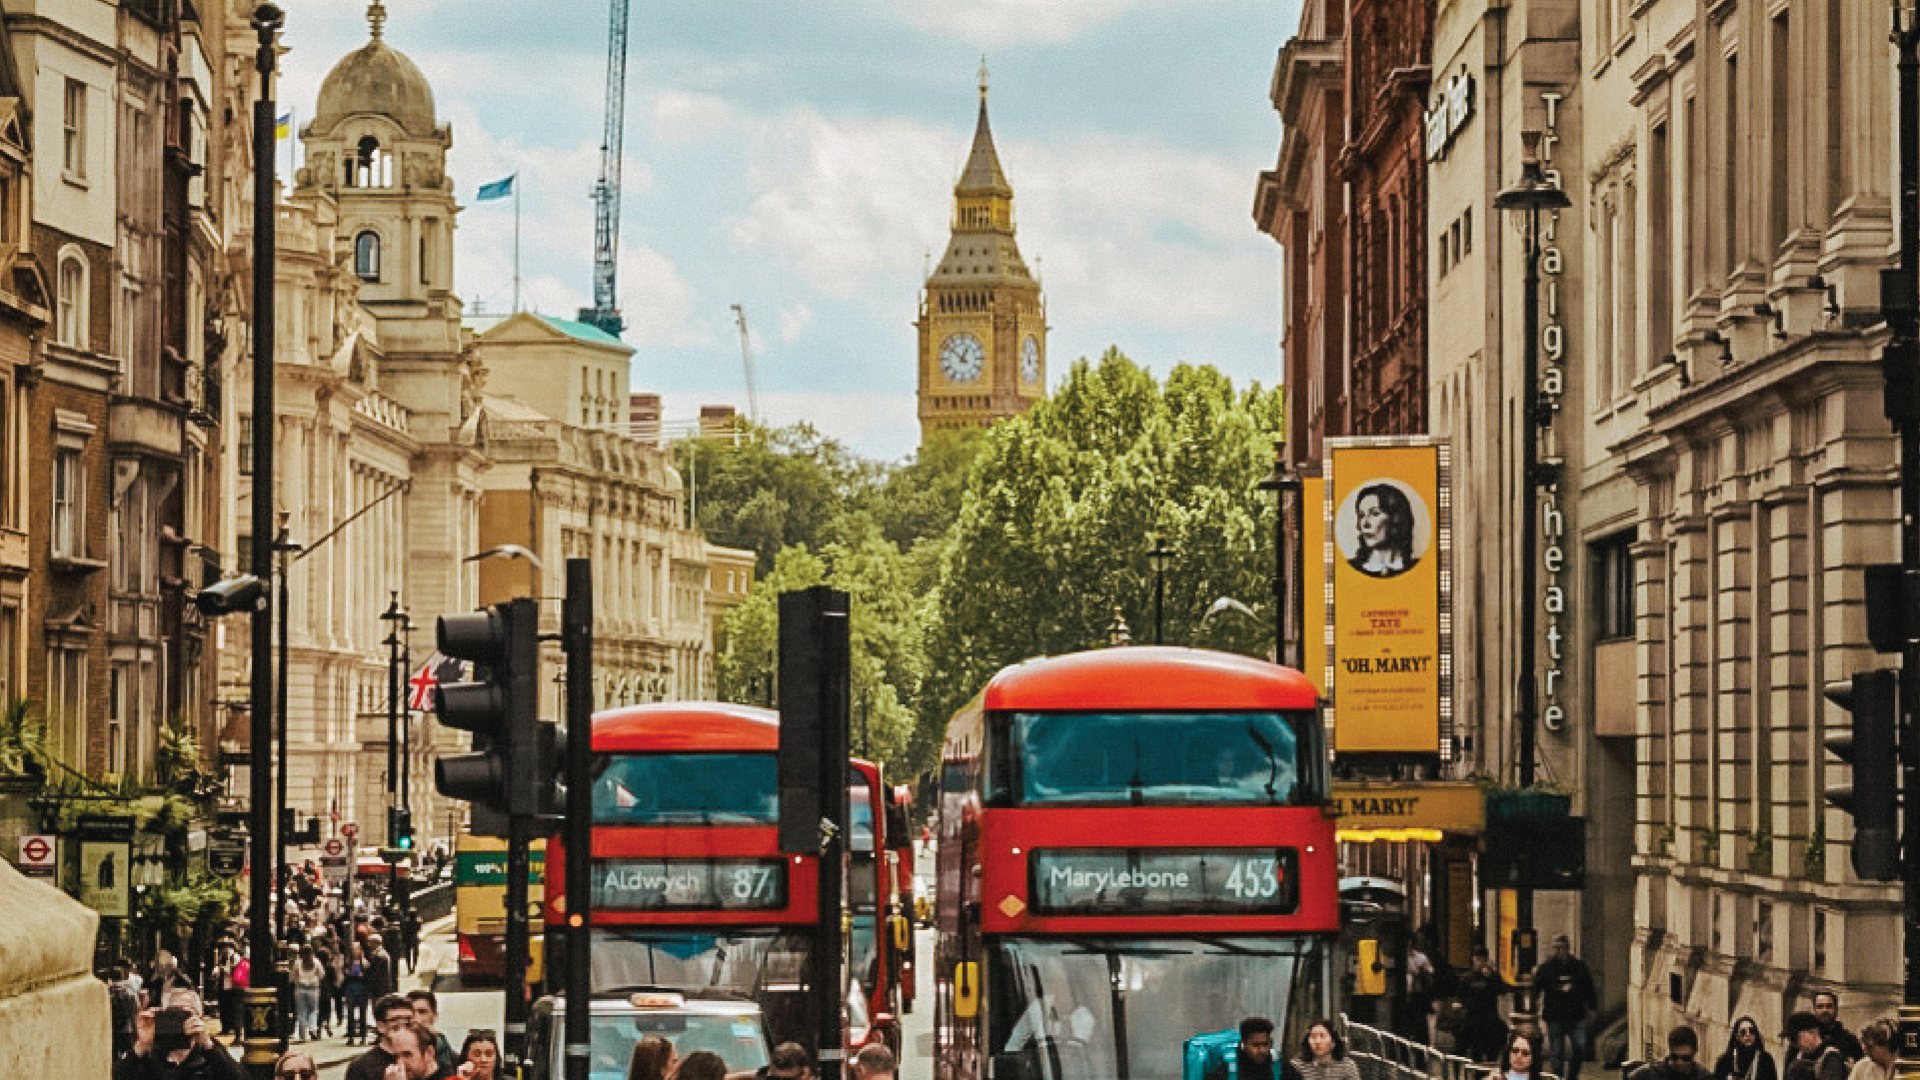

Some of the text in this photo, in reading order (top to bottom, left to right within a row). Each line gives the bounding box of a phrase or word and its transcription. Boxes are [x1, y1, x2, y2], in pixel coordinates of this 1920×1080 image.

[1369, 619, 1400, 628] TATE
[604, 868, 770, 898] Aldwych 87
[1050, 858, 1278, 898] Marylebone 453
